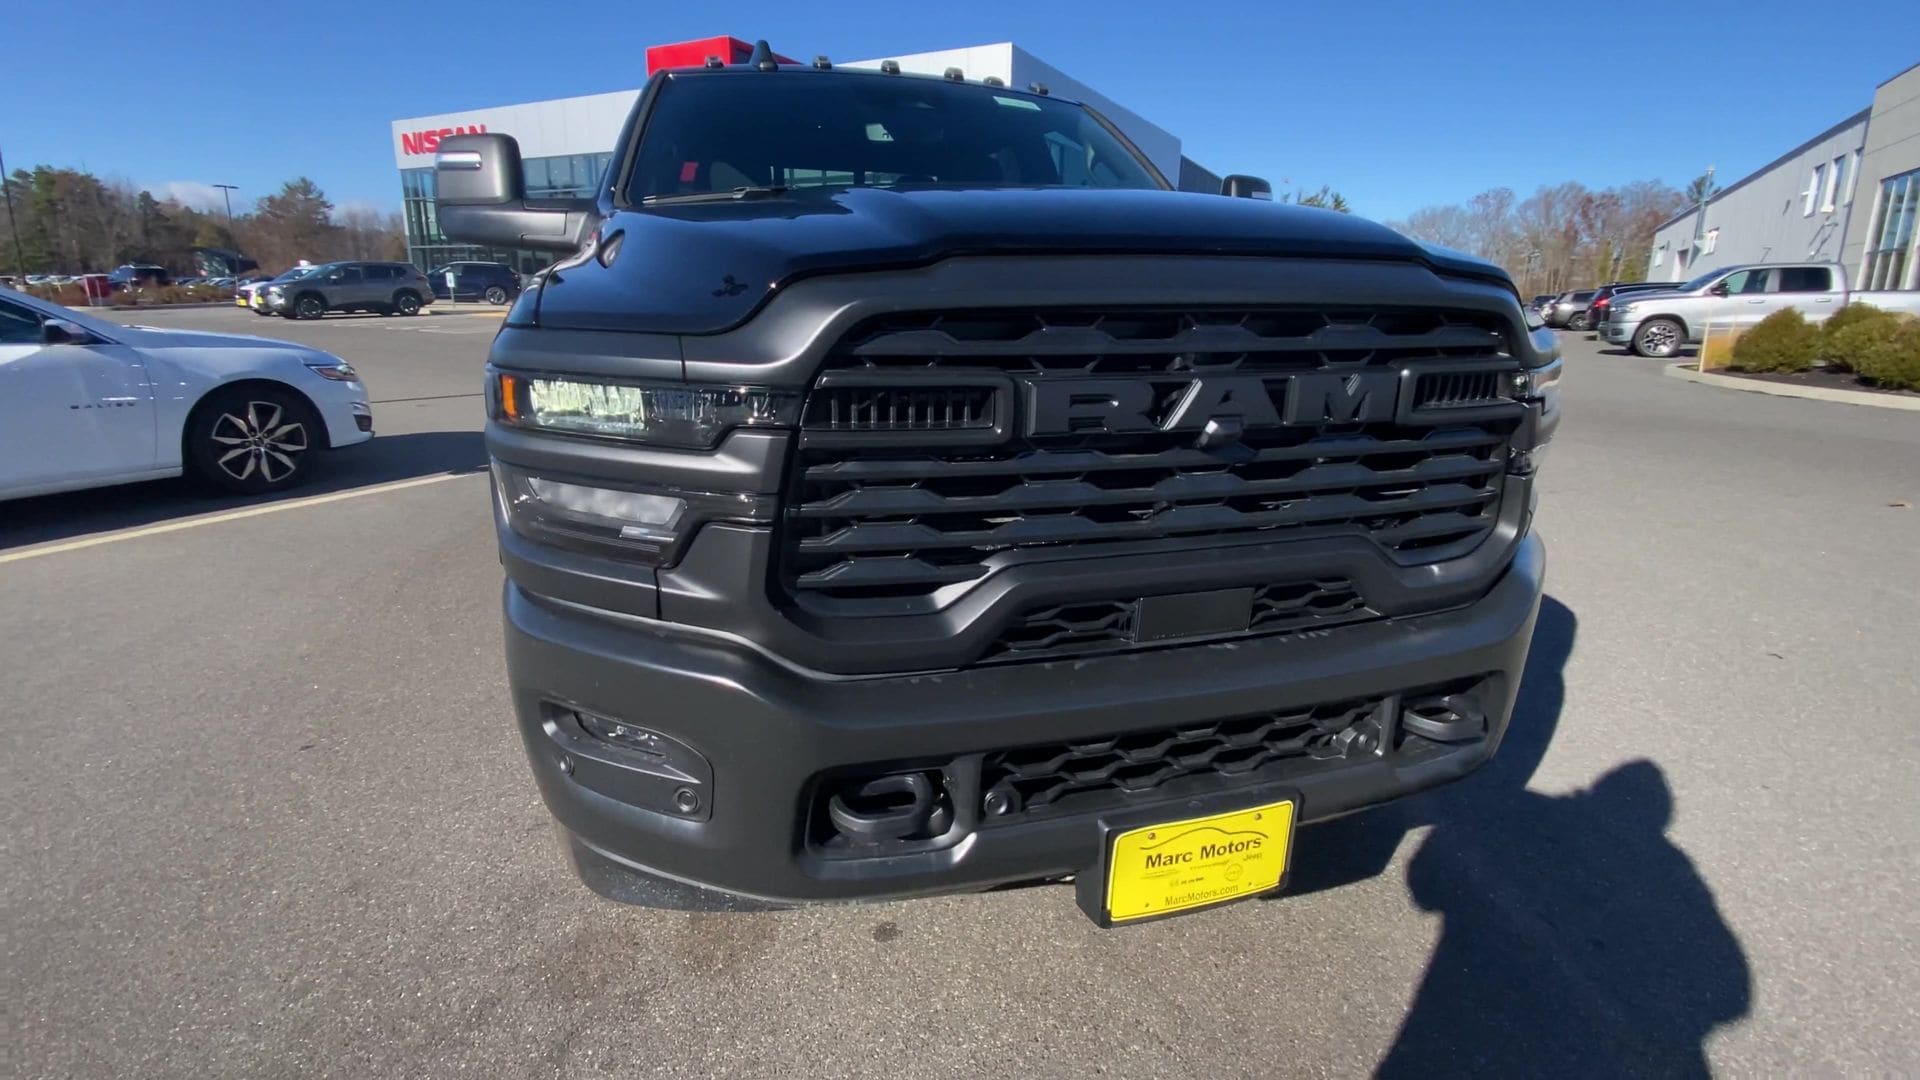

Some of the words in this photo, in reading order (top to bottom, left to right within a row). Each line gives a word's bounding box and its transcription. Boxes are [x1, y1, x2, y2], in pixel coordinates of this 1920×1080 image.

[1025, 372, 1398, 437] RAM
[1145, 851, 1193, 869] Marc
[1199, 838, 1262, 860] Motors
[1165, 884, 1239, 906] MarcMotors.com
